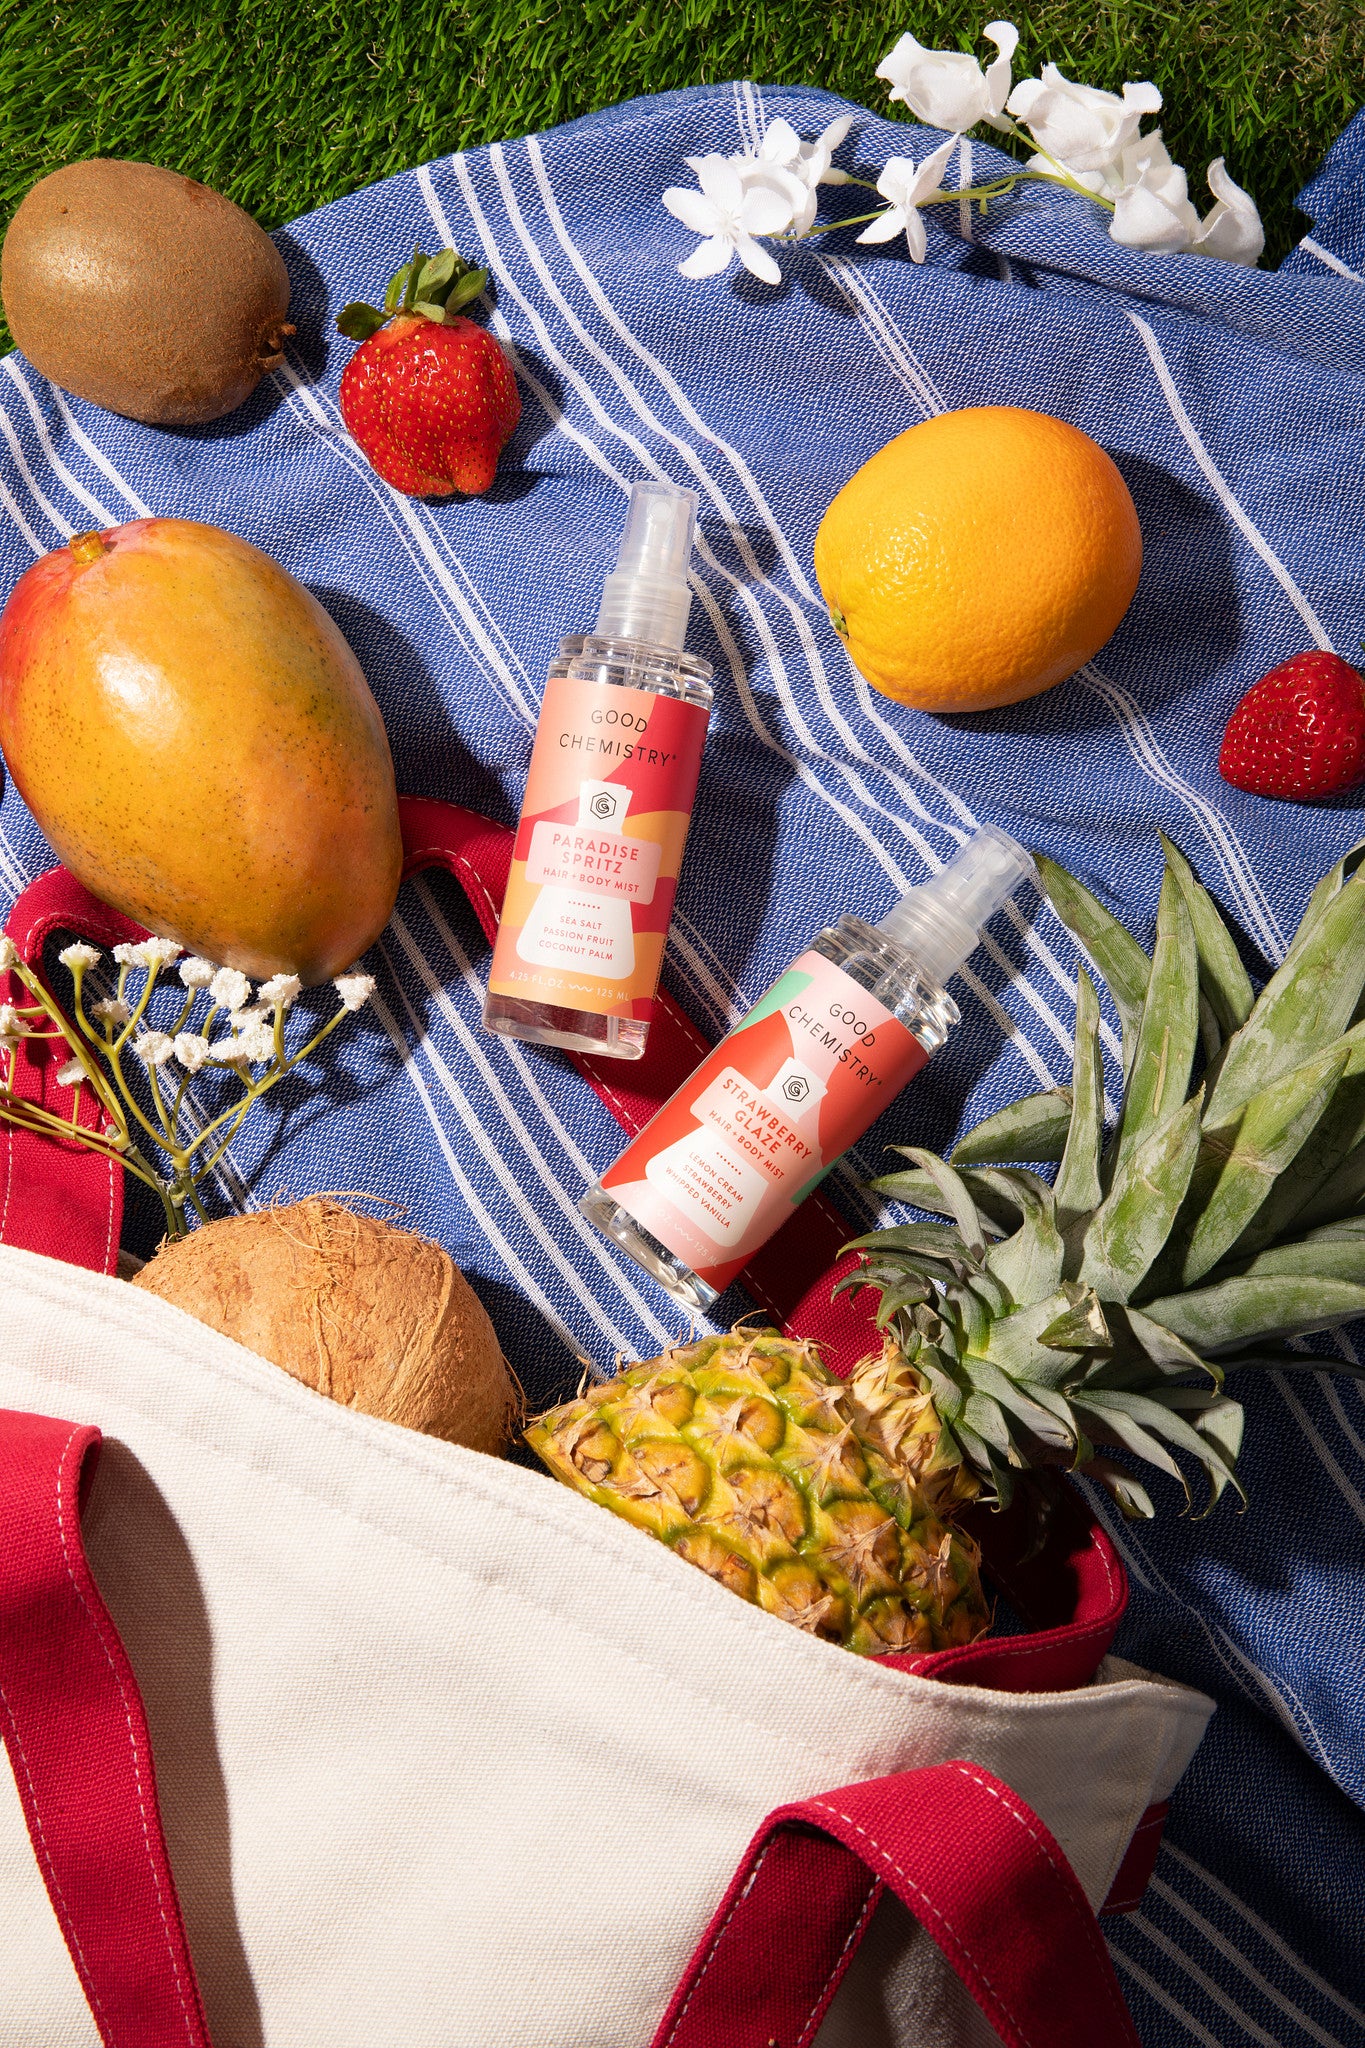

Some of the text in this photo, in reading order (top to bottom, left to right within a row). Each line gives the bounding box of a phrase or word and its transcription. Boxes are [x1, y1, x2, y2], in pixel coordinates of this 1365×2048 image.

[591, 709, 648, 733] GOOD
[552, 833, 640, 861] PARADISE
[562, 851, 624, 874] SPRITZ
[543, 866, 569, 880] HAIR
[579, 874, 611, 888] BODY
[614, 881, 640, 893] MIST
[543, 926, 614, 947] PASSION FRUIT
[560, 915, 602, 930] SEA SALT
[538, 939, 613, 961] COCONUT PALM
[596, 987, 613, 999] 125
[616, 991, 630, 1001] ML
[829, 1003, 876, 1047] GOOD
[722, 1078, 813, 1160] STRAWBERRY
[734, 1110, 782, 1154] GLAZE
[709, 1110, 732, 1132] HAIR
[737, 1135, 765, 1164] BODY
[763, 1159, 785, 1180] MIST
[682, 1164, 733, 1210] STRAWBERRY
[689, 1151, 744, 1203] LEMON CREAM
[665, 1165, 700, 1199] WHIPPED
[700, 1198, 731, 1229] VANILLA
